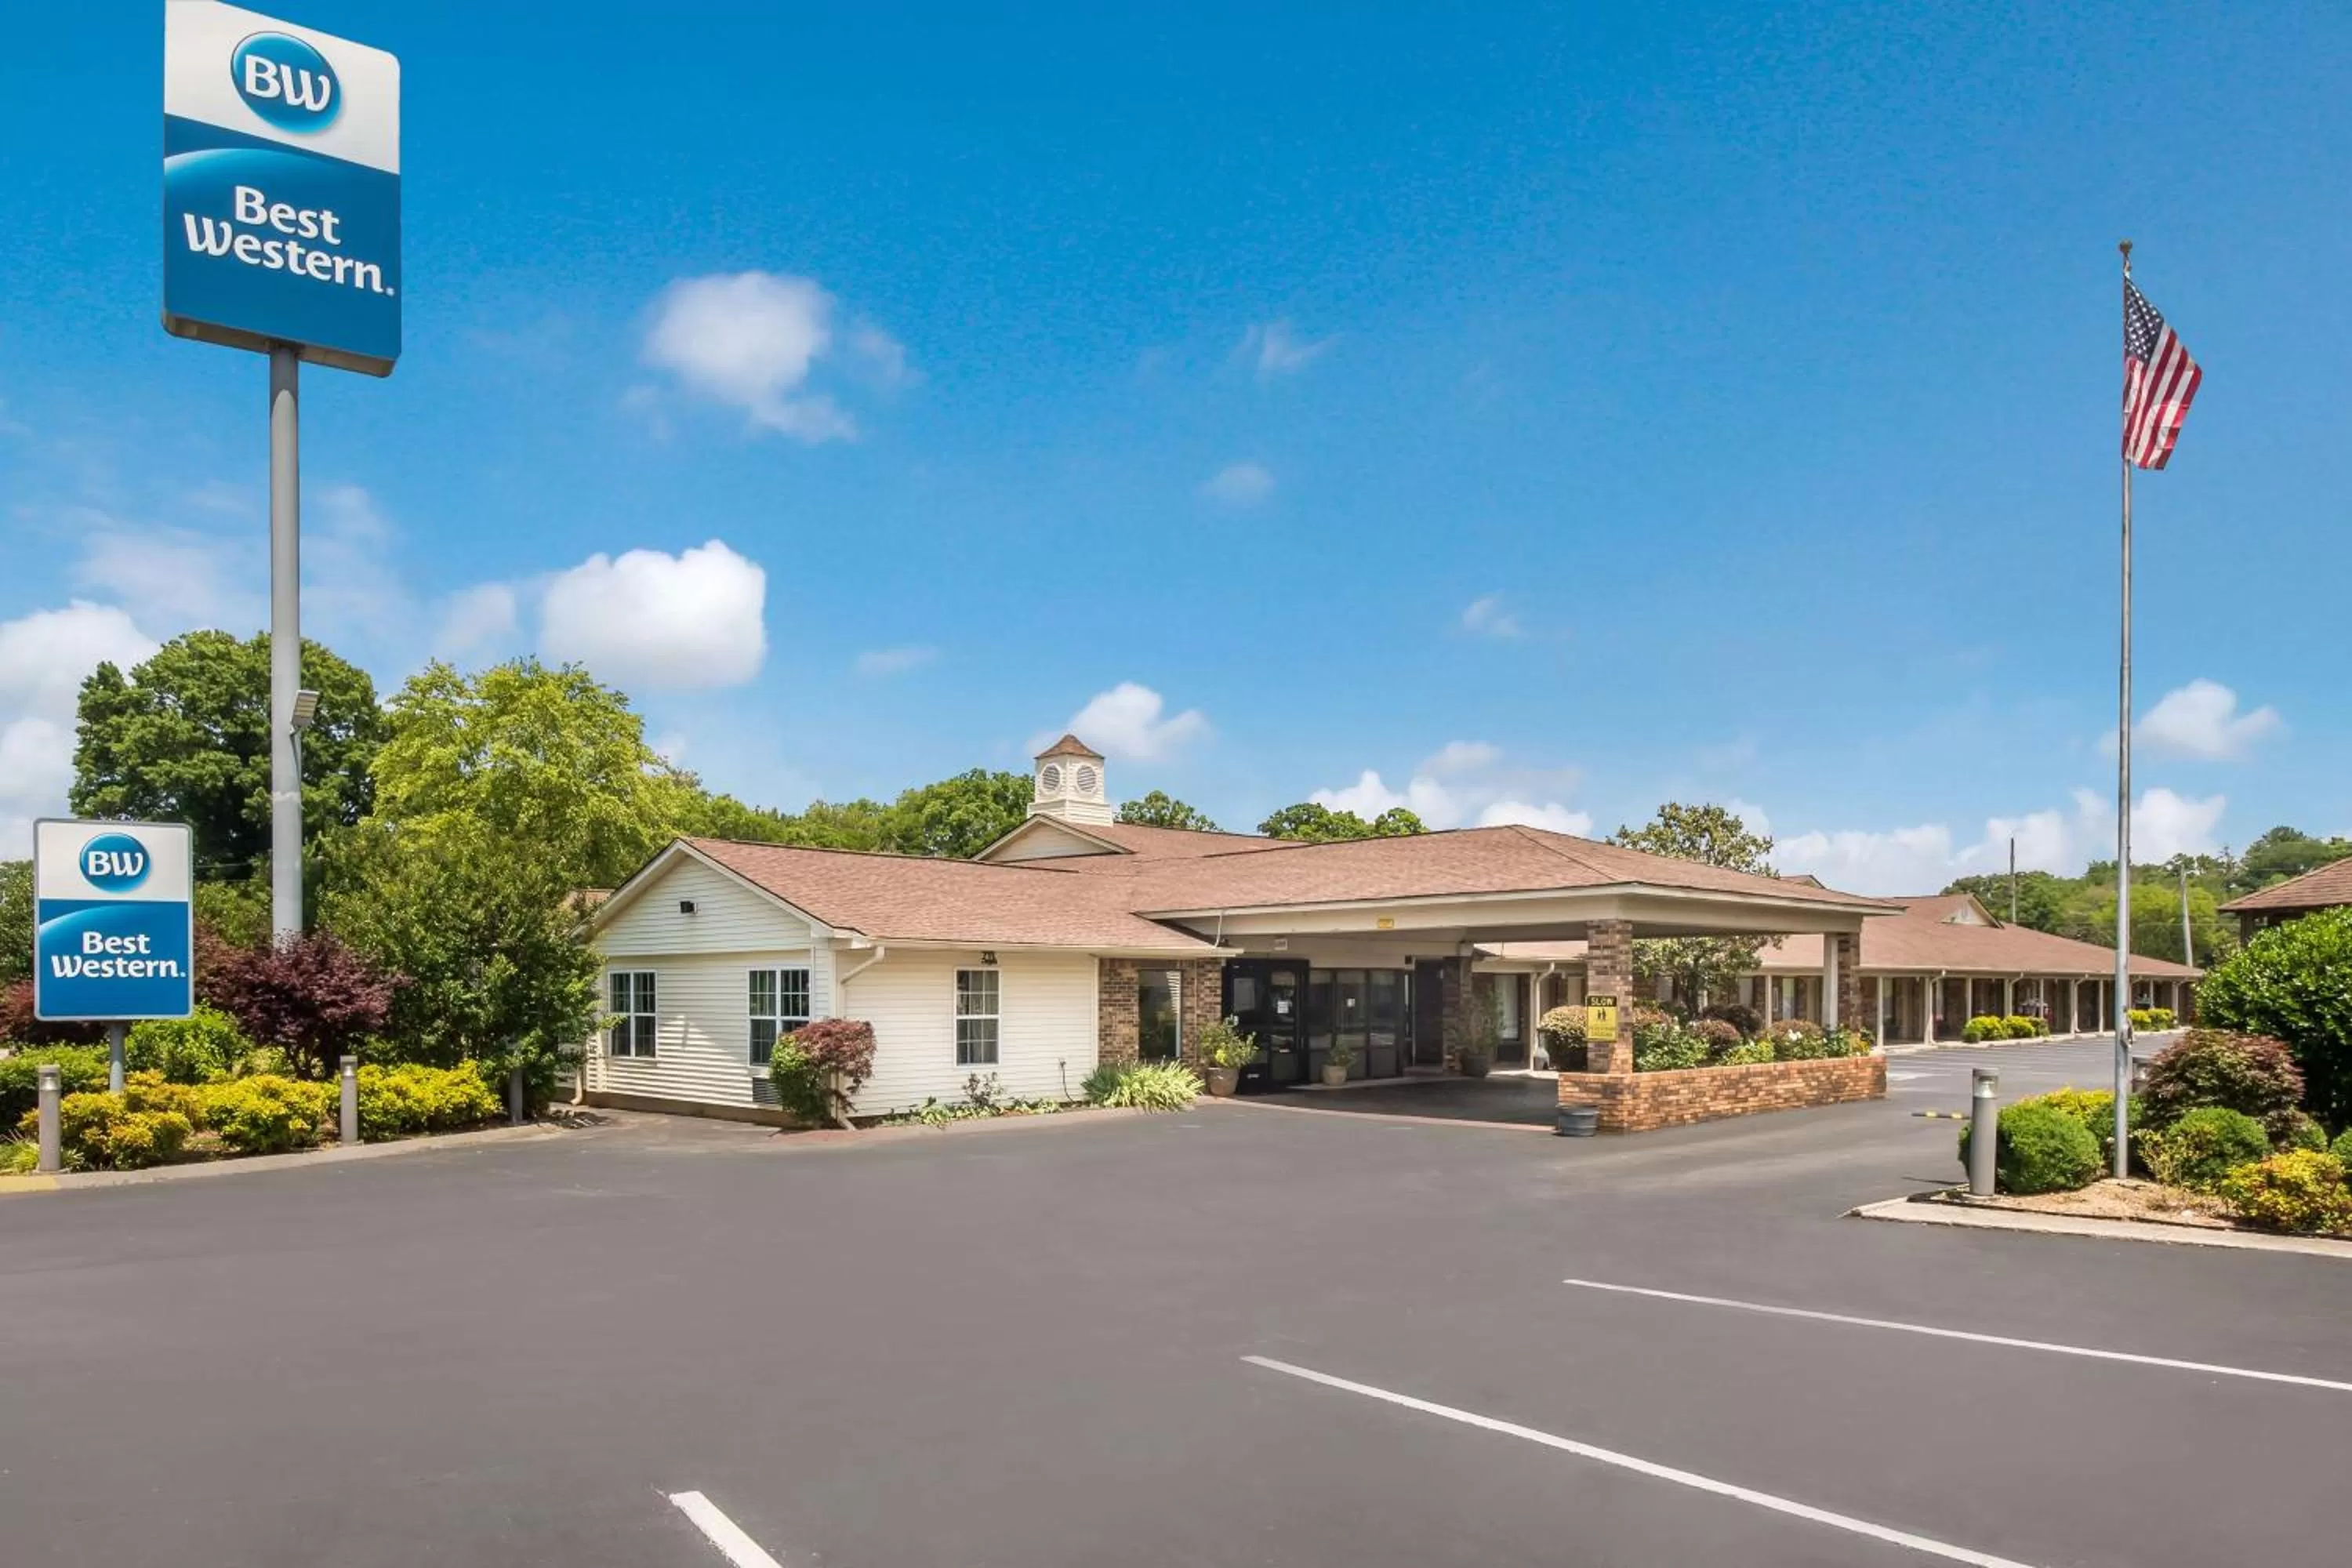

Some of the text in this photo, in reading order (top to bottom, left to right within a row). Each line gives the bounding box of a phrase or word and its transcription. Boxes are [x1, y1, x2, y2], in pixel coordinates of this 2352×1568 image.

[245, 54, 331, 112] BW
[234, 185, 340, 245] Best
[88, 851, 144, 877] BW
[82, 931, 151, 955] Best
